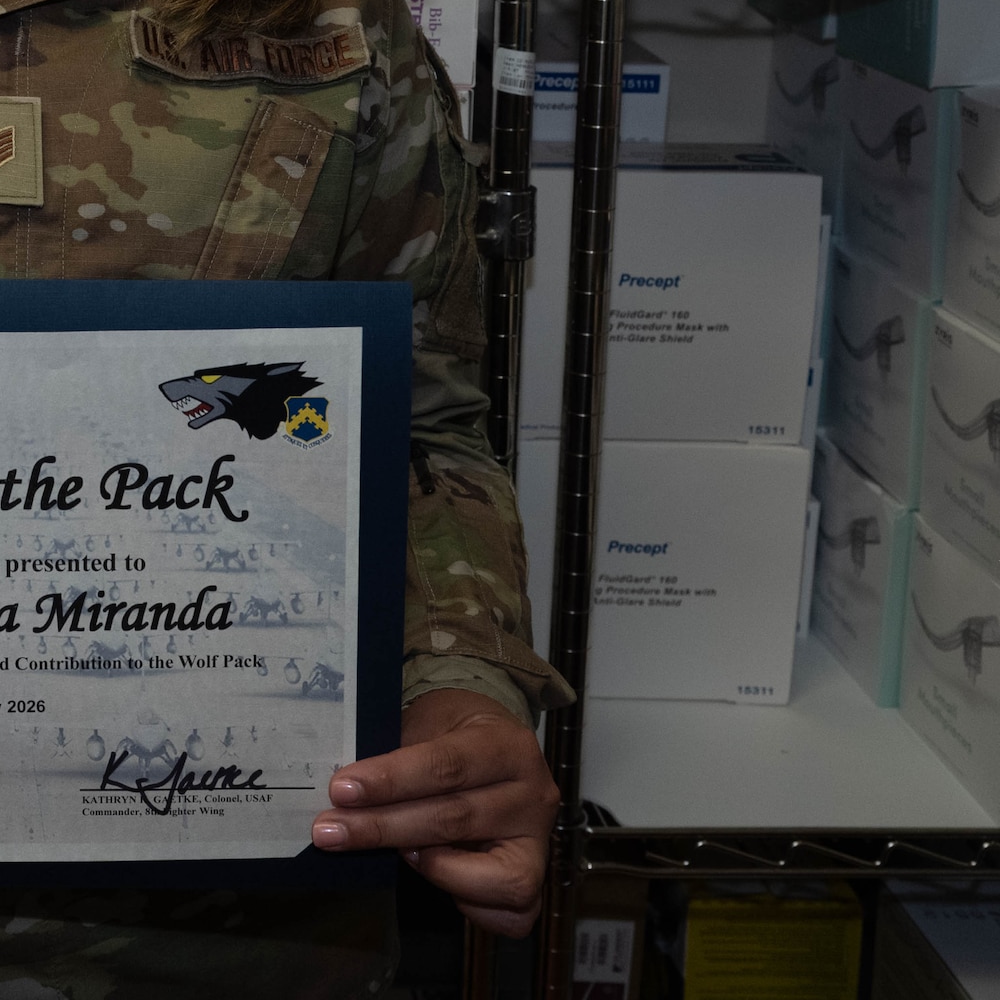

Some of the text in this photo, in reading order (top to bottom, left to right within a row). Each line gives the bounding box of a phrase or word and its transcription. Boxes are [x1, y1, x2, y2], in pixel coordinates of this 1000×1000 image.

[141, 23, 357, 77] U.S. AIR FORCE
[534, 74, 580, 90] Precep
[534, 102, 578, 110] rocedur
[619, 273, 681, 291] Precept
[671, 310, 690, 319] 160
[616, 322, 672, 332] Procedure
[676, 322, 704, 332] Mask
[706, 323, 730, 333] with
[608, 334, 694, 344] nti-Glare Shield
[748, 425, 786, 435] 15311
[0, 455, 83, 512] the
[100, 452, 250, 524] Pack
[607, 540, 669, 557] Precept
[5, 553, 114, 579] presented
[121, 555, 147, 573] to
[659, 575, 678, 584] 160
[606, 586, 661, 596] Procedure
[664, 587, 691, 596] Mask
[694, 588, 717, 597] with
[648, 598, 683, 607] Shield
[33, 585, 233, 636] Miranda
[15, 656, 123, 673] Contribution
[127, 656, 143, 671] to
[149, 655, 173, 671] the
[177, 655, 219, 671] Wolf
[222, 654, 263, 671] Pack
[737, 685, 774, 695] 15311
[7, 698, 46, 715] 2026
[82, 795, 138, 805] KATHRYN
[204, 793, 243, 805] Colonel,
[246, 793, 274, 803] USAF
[82, 808, 143, 818] Commander,
[163, 806, 197, 818] ighter
[200, 806, 225, 818] Wing
